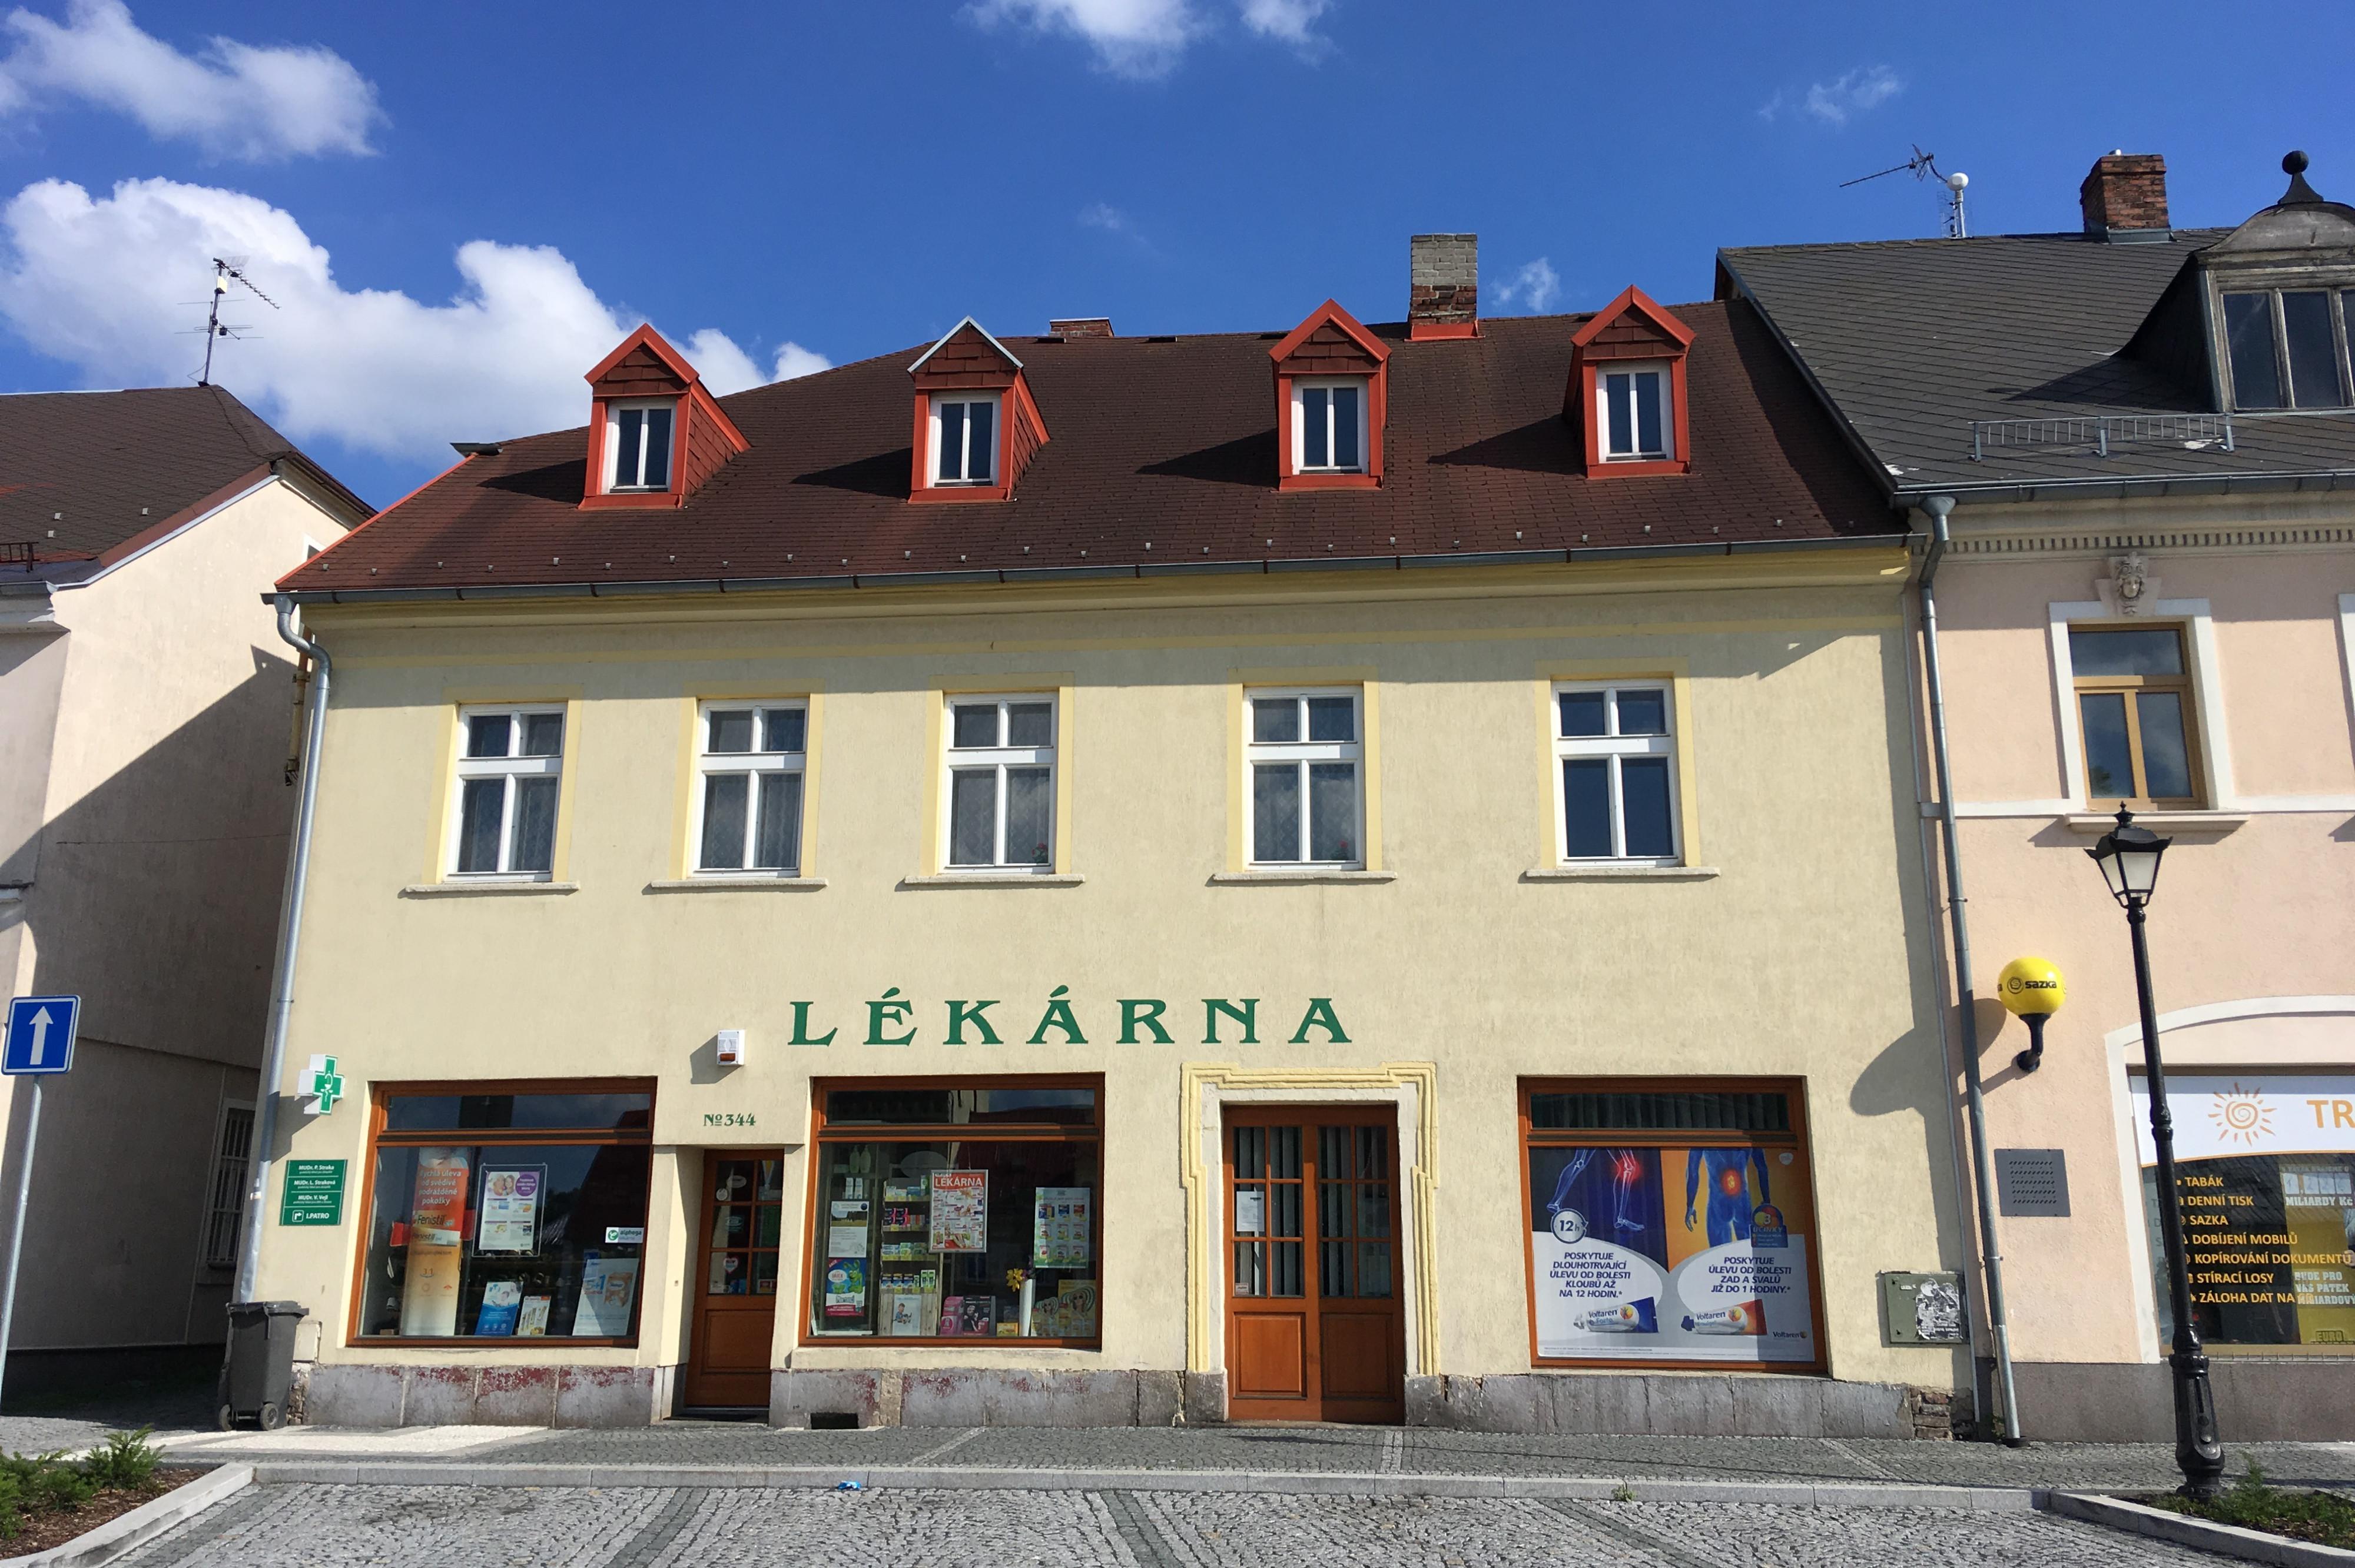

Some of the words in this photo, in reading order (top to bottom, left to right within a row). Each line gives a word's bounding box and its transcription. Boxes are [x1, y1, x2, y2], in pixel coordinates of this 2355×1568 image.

[788, 985, 1352, 1048] LÉKÁRNA
[935, 1177, 983, 1187] LÉKÁRNA
[2184, 1174, 2224, 1187] TABÁK
[2187, 1194, 2225, 1206] DENNÍ
[2228, 1195, 2254, 1206] TISK
[2285, 1196, 2336, 1206] MILIARDY
[2339, 1196, 2353, 1206] Kč
[417, 1214, 446, 1225] Fenistil
[2190, 1215, 2228, 1225] SAZKA
[2192, 1232, 2247, 1244] DOBÍJENÍ
[2250, 1231, 2298, 1244] MOBILŮ
[1724, 1257, 1774, 1265] POSKYTUJE
[2195, 1251, 2269, 1264] KOPÍROVÁNÍ
[2272, 1250, 2351, 1264] DOKUMENTŮ
[1553, 1260, 1627, 1270] DLOUHOTRVAJÍCÍ
[1709, 1264, 1737, 1274] ÚLEVU
[1550, 1269, 1578, 1278] ÚLEVU
[2197, 1271, 2243, 1283] STÍRACÍ
[2245, 1273, 2274, 1283] LOSY
[2323, 1271, 2343, 1281] PRO
[1565, 1278, 1601, 1288] KLOUBŮ
[1603, 1279, 1616, 1288] AŽ
[1742, 1275, 1749, 1284] A
[1752, 1274, 1781, 1284] SVALŮ
[1711, 1284, 1724, 1293] JIŽ
[2317, 1281, 2349, 1293] PÁTEK
[2200, 1290, 2248, 1303] ZÁLOHA
[2251, 1293, 2274, 1303] DAT
[2277, 1293, 2296, 1303] NA
[1588, 1308, 1618, 1318] Voltaren
[1696, 1311, 1726, 1320] Voltaren
